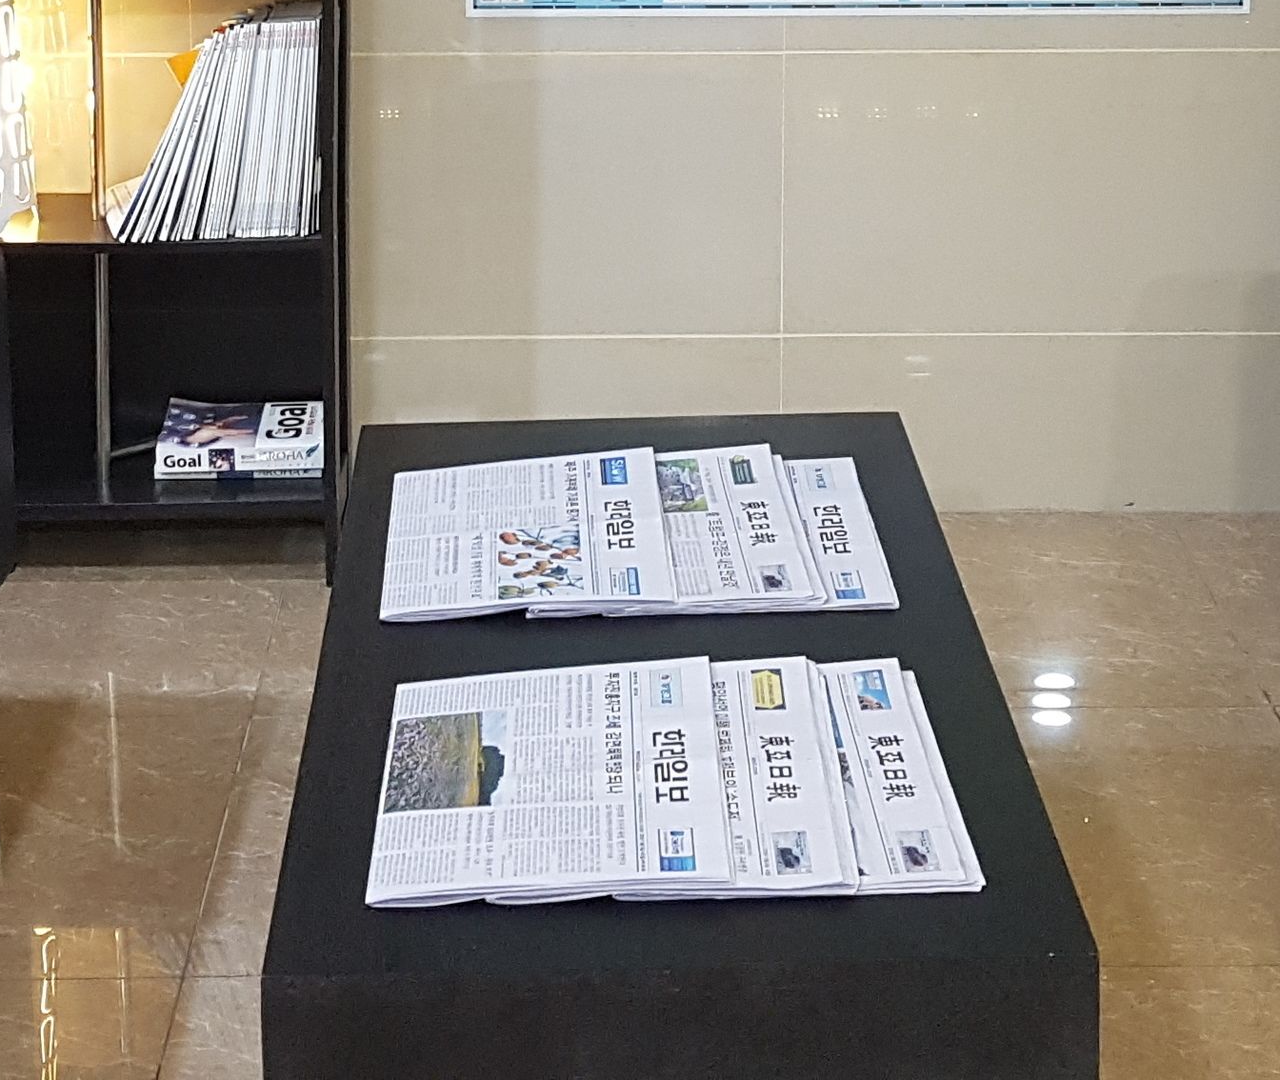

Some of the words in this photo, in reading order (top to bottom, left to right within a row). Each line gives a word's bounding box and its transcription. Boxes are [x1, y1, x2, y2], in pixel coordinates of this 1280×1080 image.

[265, 402, 308, 440] Goal
[163, 453, 203, 469] Goal
[609, 458, 626, 484] SLOW
[604, 499, 636, 550] 한라일보
[740, 500, 779, 547] 東亞日報
[813, 504, 852, 555] 한라일보
[652, 728, 690, 804] 한라일보
[759, 735, 801, 802] 東亞日報
[867, 734, 917, 802] 東亞日報
